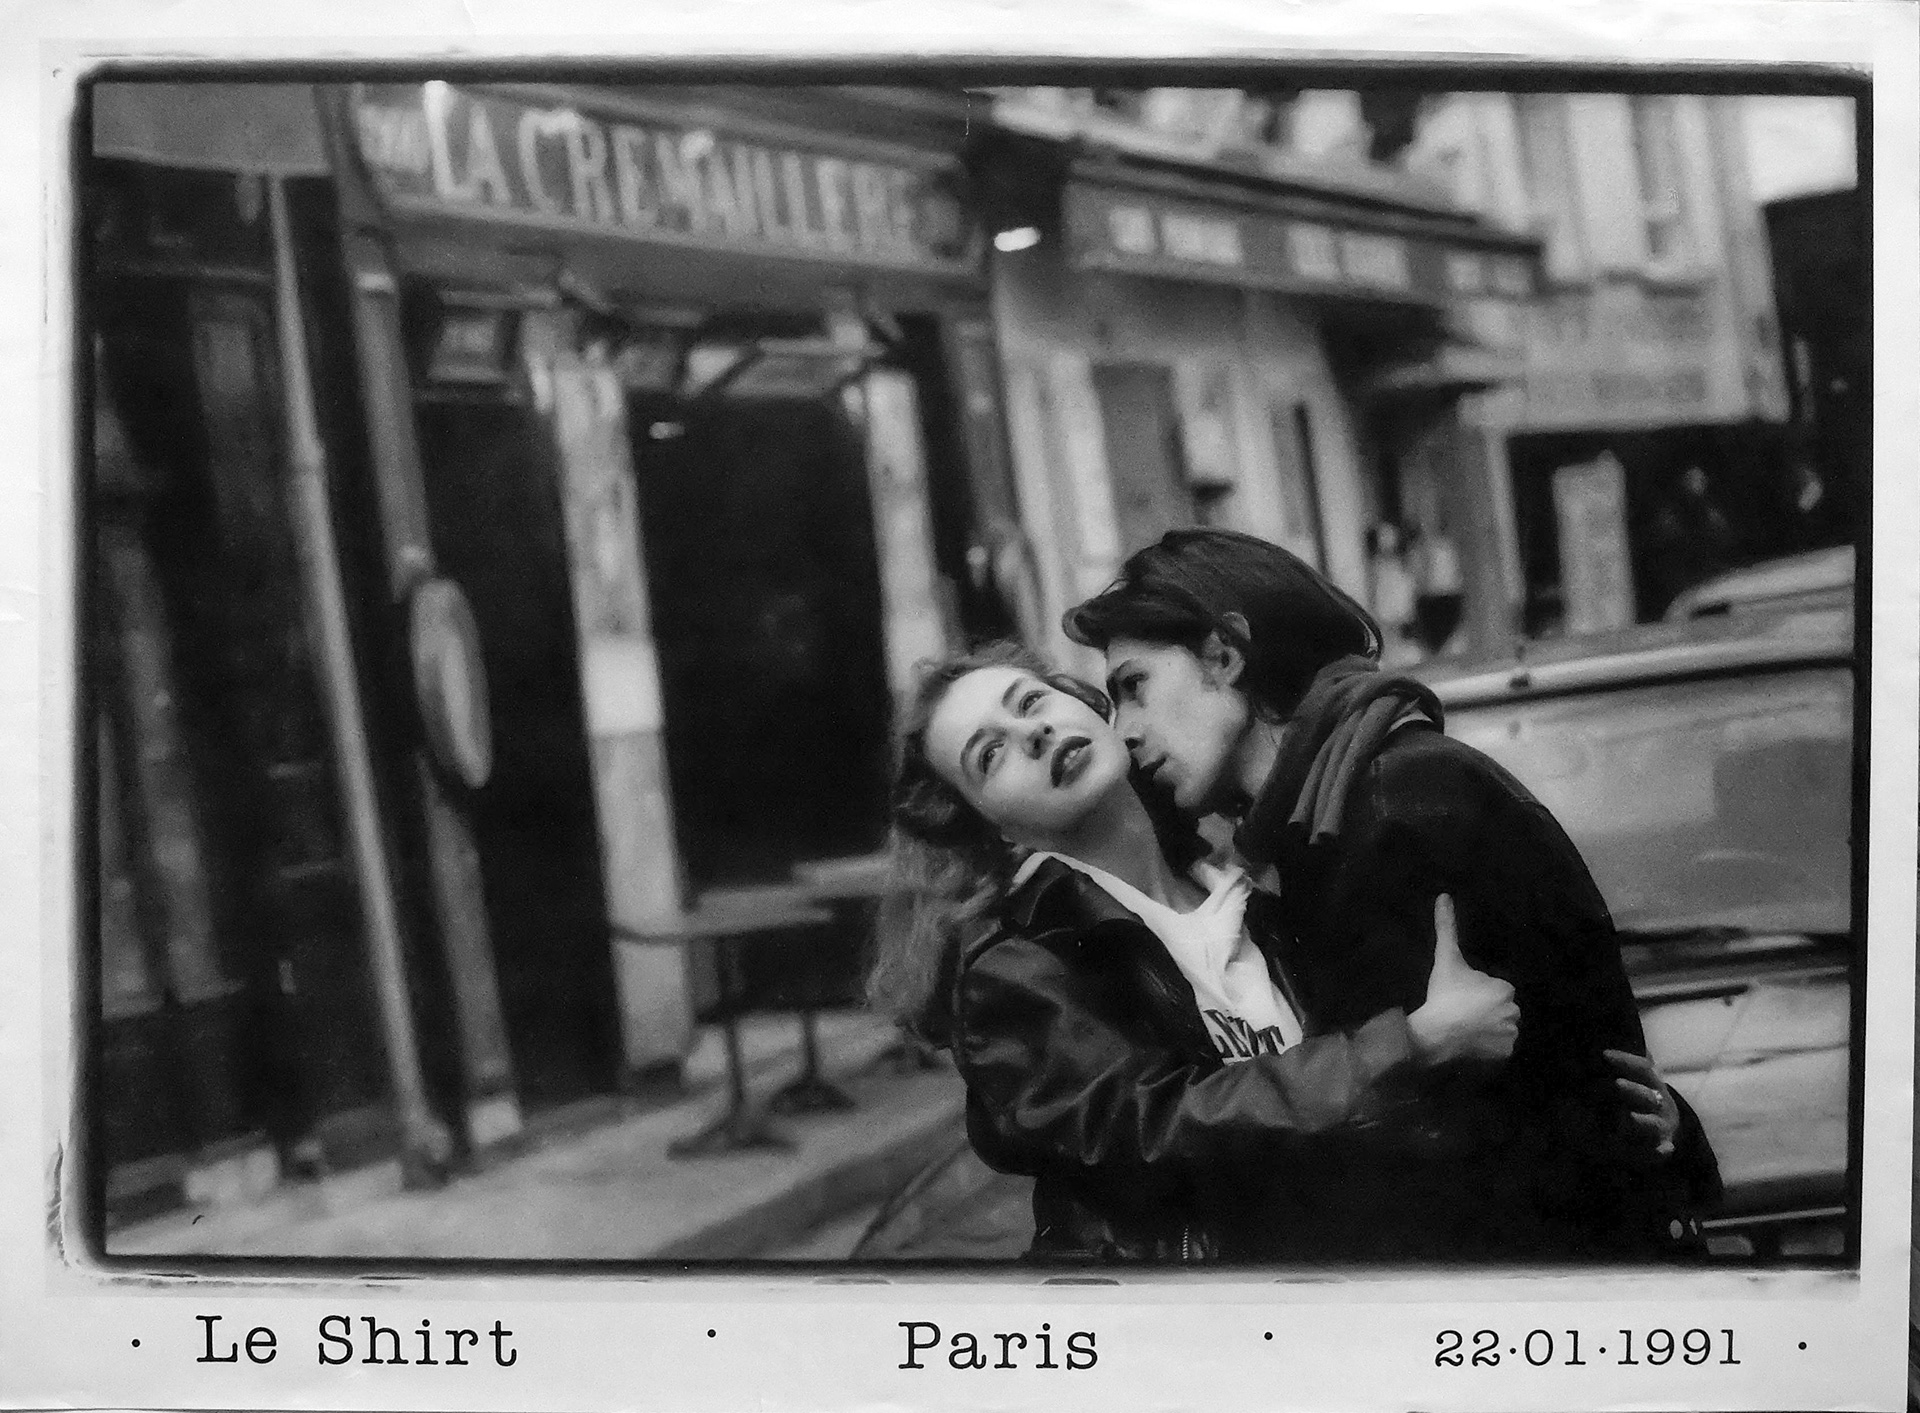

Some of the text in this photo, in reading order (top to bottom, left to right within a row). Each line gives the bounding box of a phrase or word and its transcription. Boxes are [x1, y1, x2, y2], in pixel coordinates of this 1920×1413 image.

[422, 82, 511, 204] LA
[196, 1315, 278, 1365] Le
[318, 1314, 517, 1367] Shirt
[898, 1321, 1099, 1371] Paris
